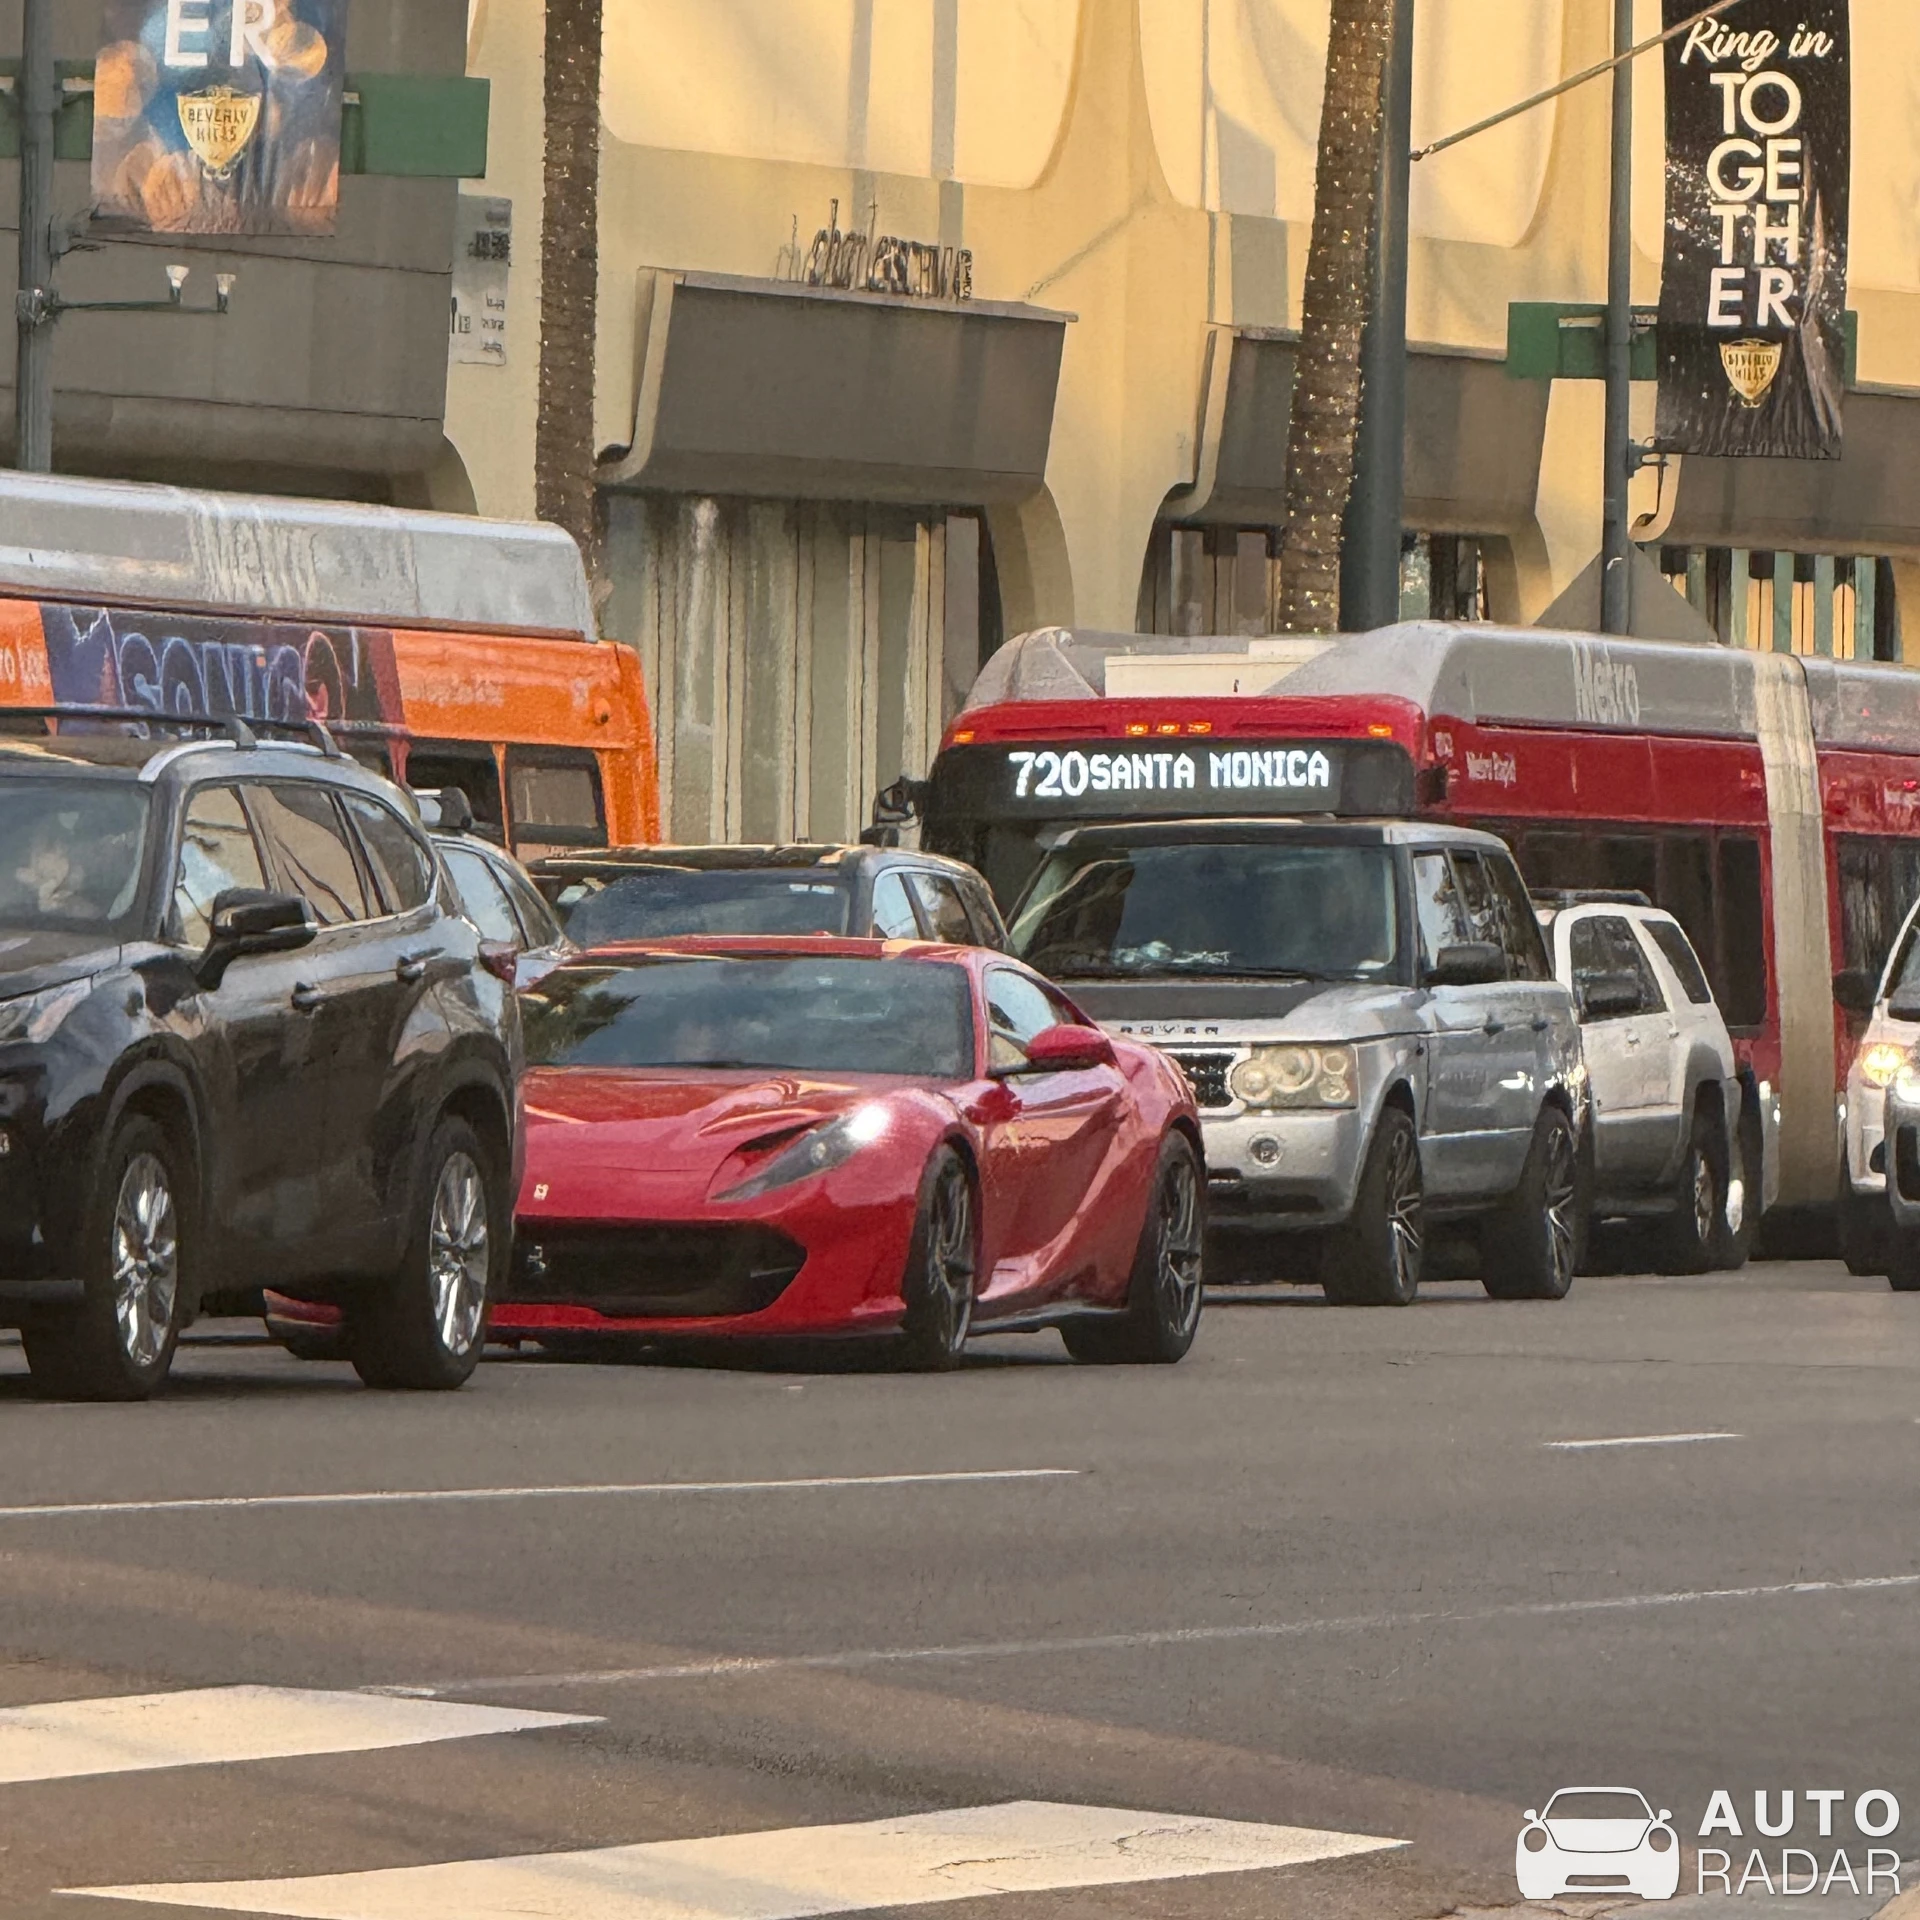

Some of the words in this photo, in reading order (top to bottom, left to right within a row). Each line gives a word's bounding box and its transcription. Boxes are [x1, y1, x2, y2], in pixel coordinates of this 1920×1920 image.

[164, 0, 277, 67] ER
[1680, 16, 1780, 71] Ring
[1788, 23, 1834, 59] in
[1710, 71, 1802, 135] TO
[1707, 138, 1802, 201] GE
[1710, 204, 1800, 265] TH
[1707, 267, 1796, 327] ER
[1008, 751, 1089, 797] 720
[1089, 752, 1195, 789] SANTA
[1208, 751, 1330, 788] MONICA
